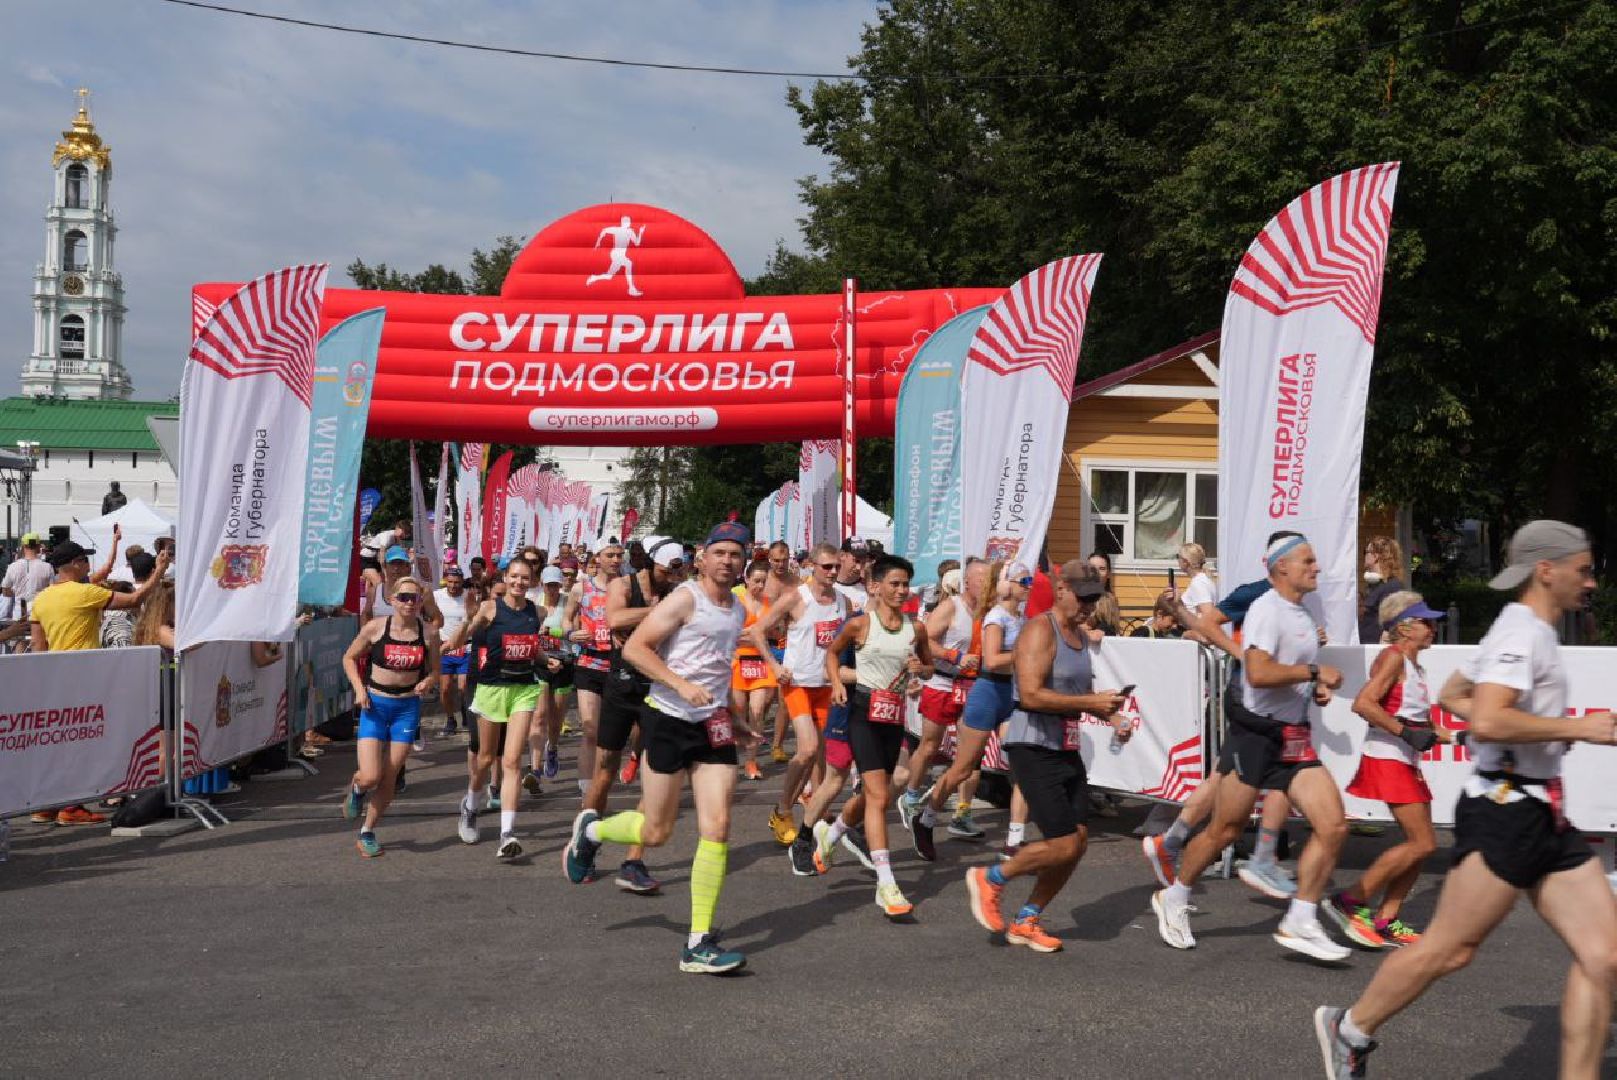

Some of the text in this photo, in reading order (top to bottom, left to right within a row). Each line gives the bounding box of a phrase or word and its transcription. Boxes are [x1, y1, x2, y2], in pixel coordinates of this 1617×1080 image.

[450, 311, 795, 353] СУПЕРЛИГА
[450, 359, 795, 397] ПОДМОСКОВЬЯ
[547, 410, 700, 428] суперлигамо.рф
[1269, 353, 1300, 519] СУПЕРЛИГА
[1286, 353, 1317, 516] ПОДМОСКОВЬЯ
[246, 428, 270, 539] Губернатора
[1006, 423, 1034, 531] Губернатора
[224, 463, 246, 539] Команда
[386, 654, 415, 667] 2207
[505, 644, 532, 658] 2027
[0, 704, 105, 734] СУПЕРЛИГА
[872, 701, 900, 721] 2321
